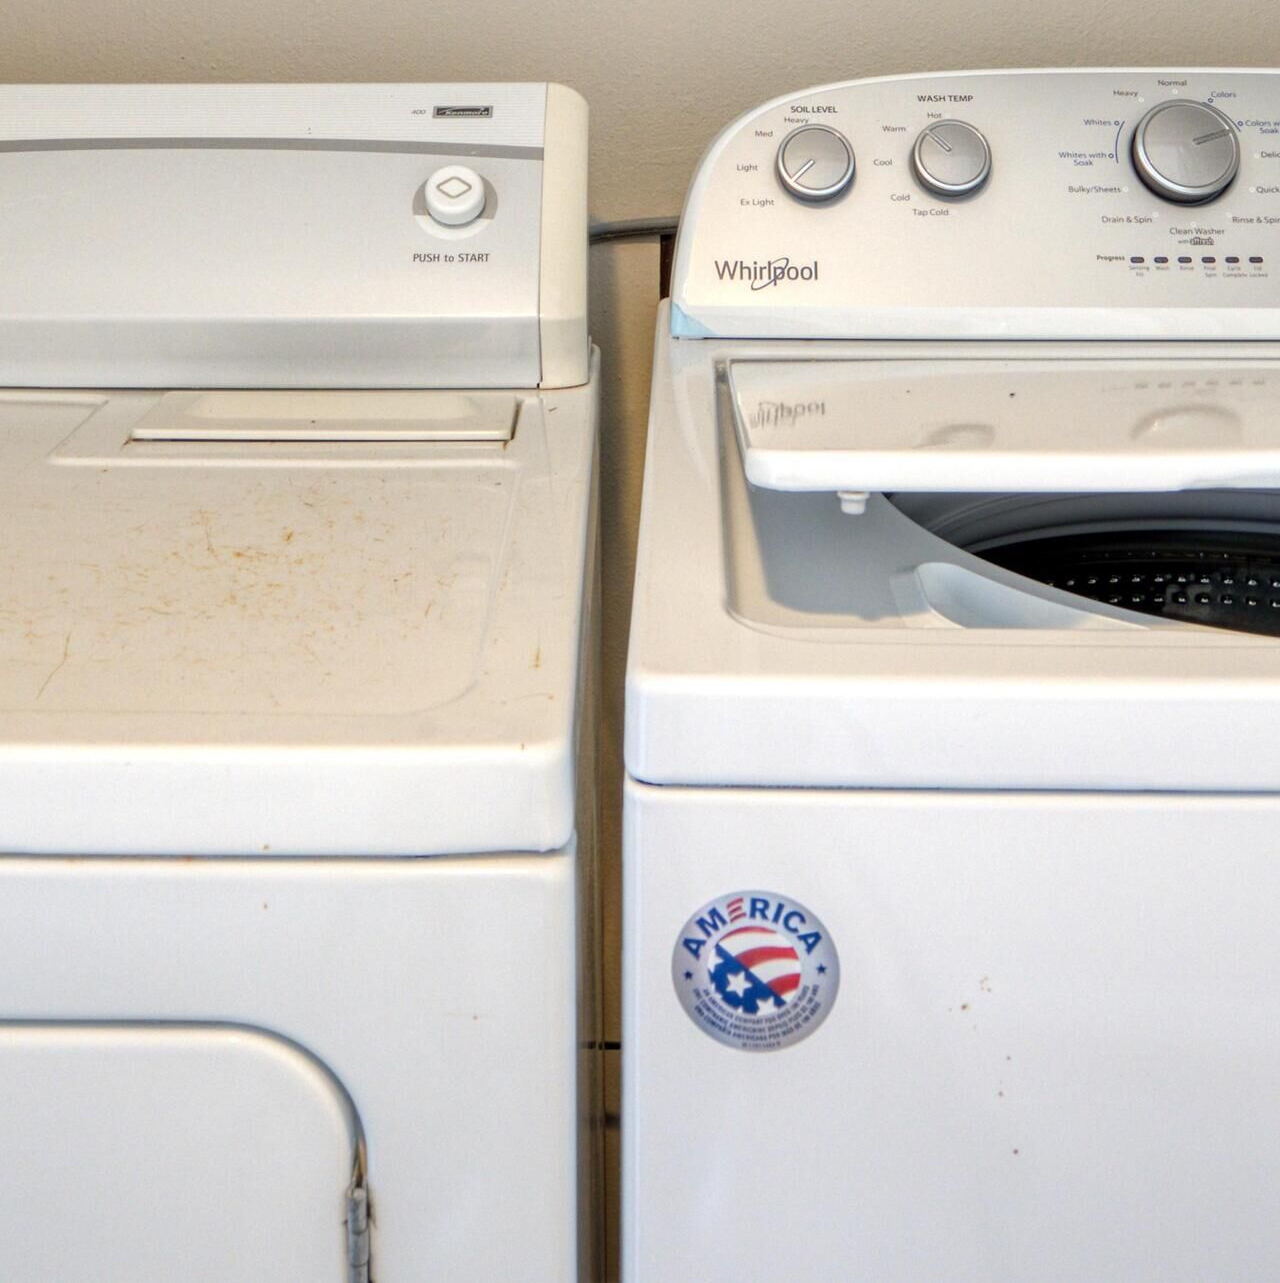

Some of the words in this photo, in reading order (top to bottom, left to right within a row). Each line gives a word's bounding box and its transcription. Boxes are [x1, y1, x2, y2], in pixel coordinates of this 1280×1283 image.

[917, 94, 946, 102] WASH
[947, 94, 974, 102] TEMP
[790, 106, 810, 114] SOIL
[812, 106, 838, 114] LEVEL
[784, 117, 810, 125] Heavy
[755, 130, 773, 138] Med
[737, 164, 758, 172] Light
[1068, 186, 1122, 194] Bulky/Sheets
[1256, 186, 1280, 194] Quick
[890, 194, 910, 202] Cold
[740, 198, 750, 206] Ex
[753, 198, 774, 207] Light
[912, 208, 928, 218] Tap
[930, 208, 949, 216] Cold
[1134, 216, 1152, 224] Spin
[413, 254, 440, 262] PUSH
[444, 254, 454, 262] to
[458, 254, 490, 262] START
[1096, 254, 1125, 262] Progress
[714, 259, 818, 288] Whirlpool
[682, 898, 823, 961] AMERICA
